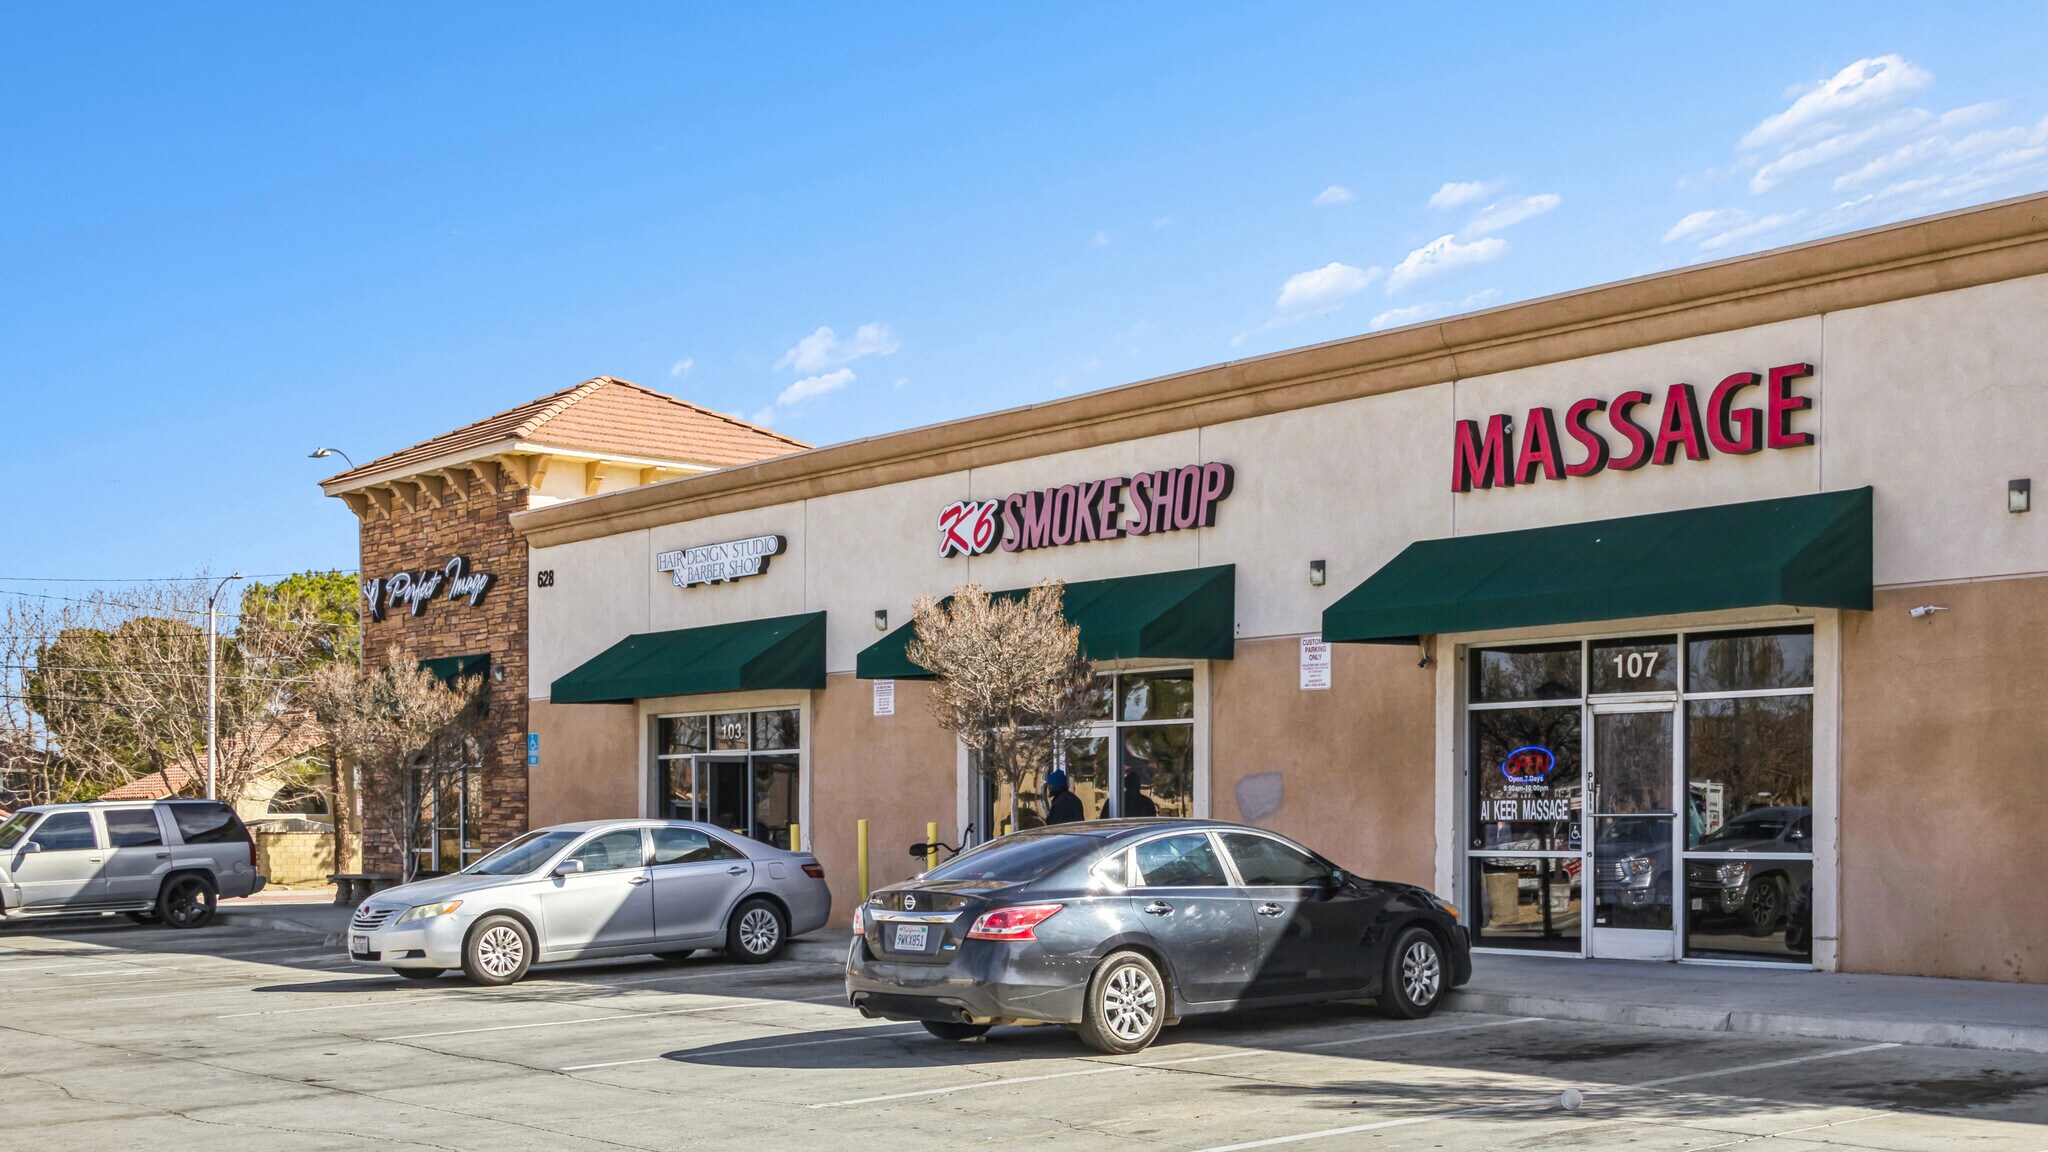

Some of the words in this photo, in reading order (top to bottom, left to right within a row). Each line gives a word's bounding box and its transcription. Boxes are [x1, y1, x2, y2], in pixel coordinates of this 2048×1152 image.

[1451, 363, 1814, 493] MASSAGE
[659, 553, 684, 570] HAIR
[687, 544, 729, 565] DESIGN
[733, 536, 777, 558] STUDIO
[537, 570, 554, 588] 628
[674, 568, 684, 585] &
[688, 563, 729, 582] BARBER
[729, 557, 761, 576] SHOP
[386, 571, 442, 616] Perfect
[445, 556, 490, 606] Image
[1304, 645, 1327, 653] PARKING
[1613, 652, 1658, 678] 107
[722, 723, 742, 740] 103
[1505, 754, 1551, 775] OPEN
[1508, 775, 1524, 783] Open
[1529, 775, 1544, 783] Days
[1493, 800, 1518, 820] KEER
[1522, 799, 1569, 820] MASSAGE
